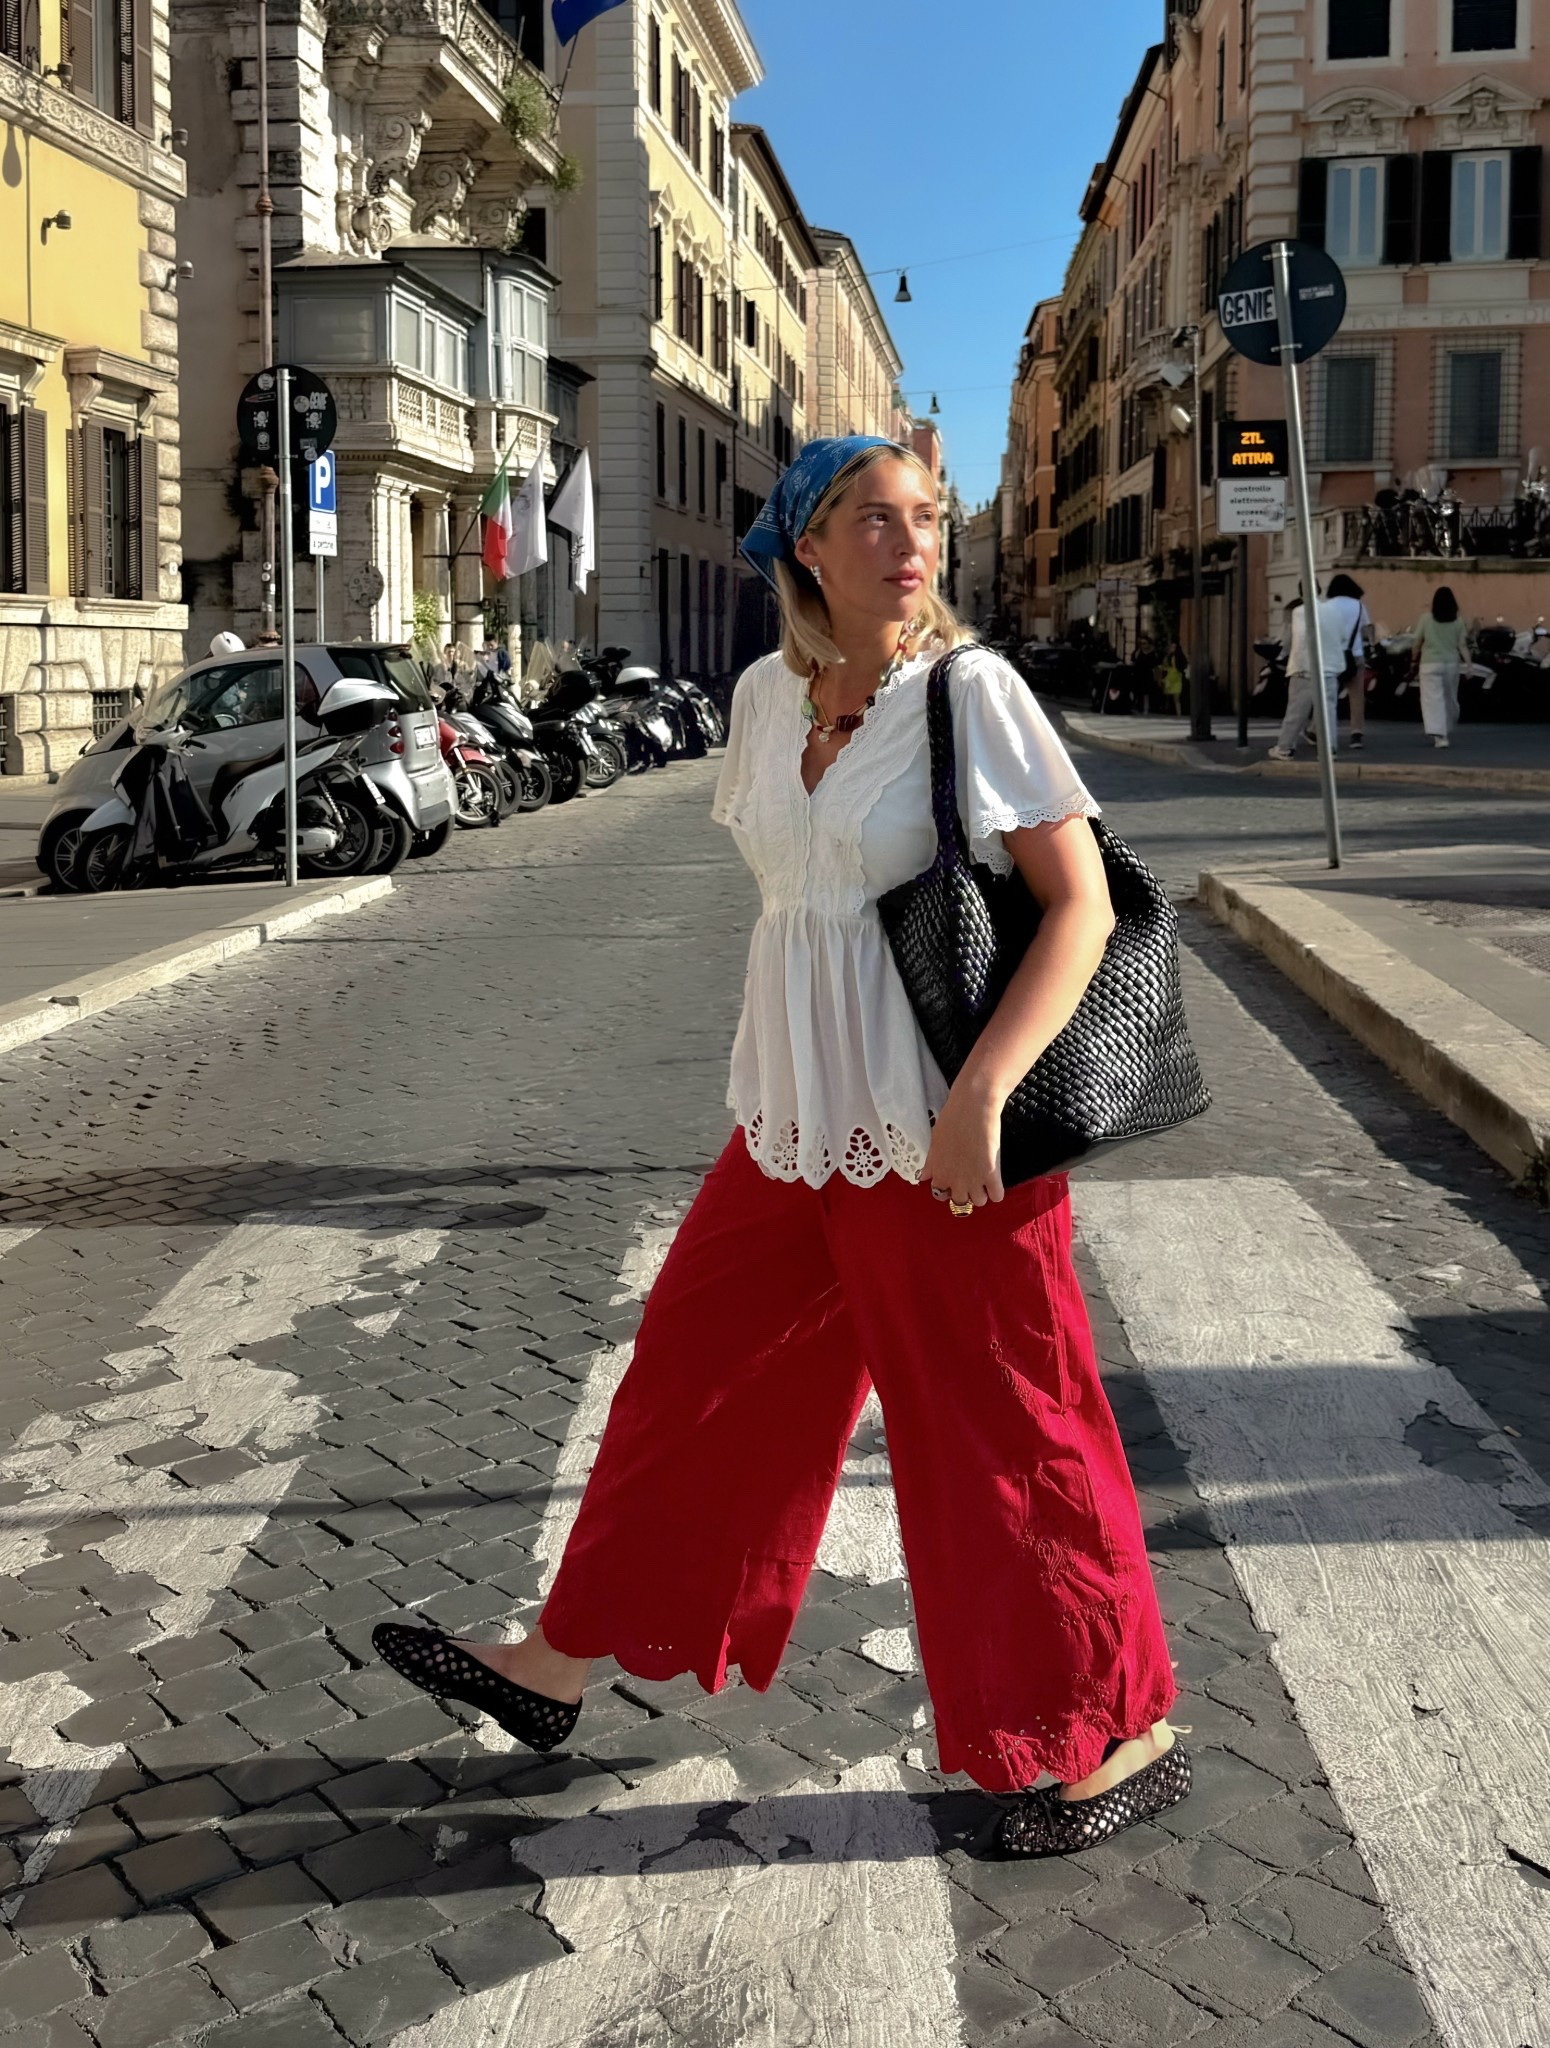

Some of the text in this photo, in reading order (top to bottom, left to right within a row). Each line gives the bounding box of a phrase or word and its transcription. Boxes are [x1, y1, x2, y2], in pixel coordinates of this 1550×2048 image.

[1222, 289, 1274, 325] GENIE
[1241, 432, 1265, 445] ZTL
[1232, 452, 1274, 465] ATTIVA
[315, 456, 331, 504] P
[1233, 485, 1272, 493] controllo
